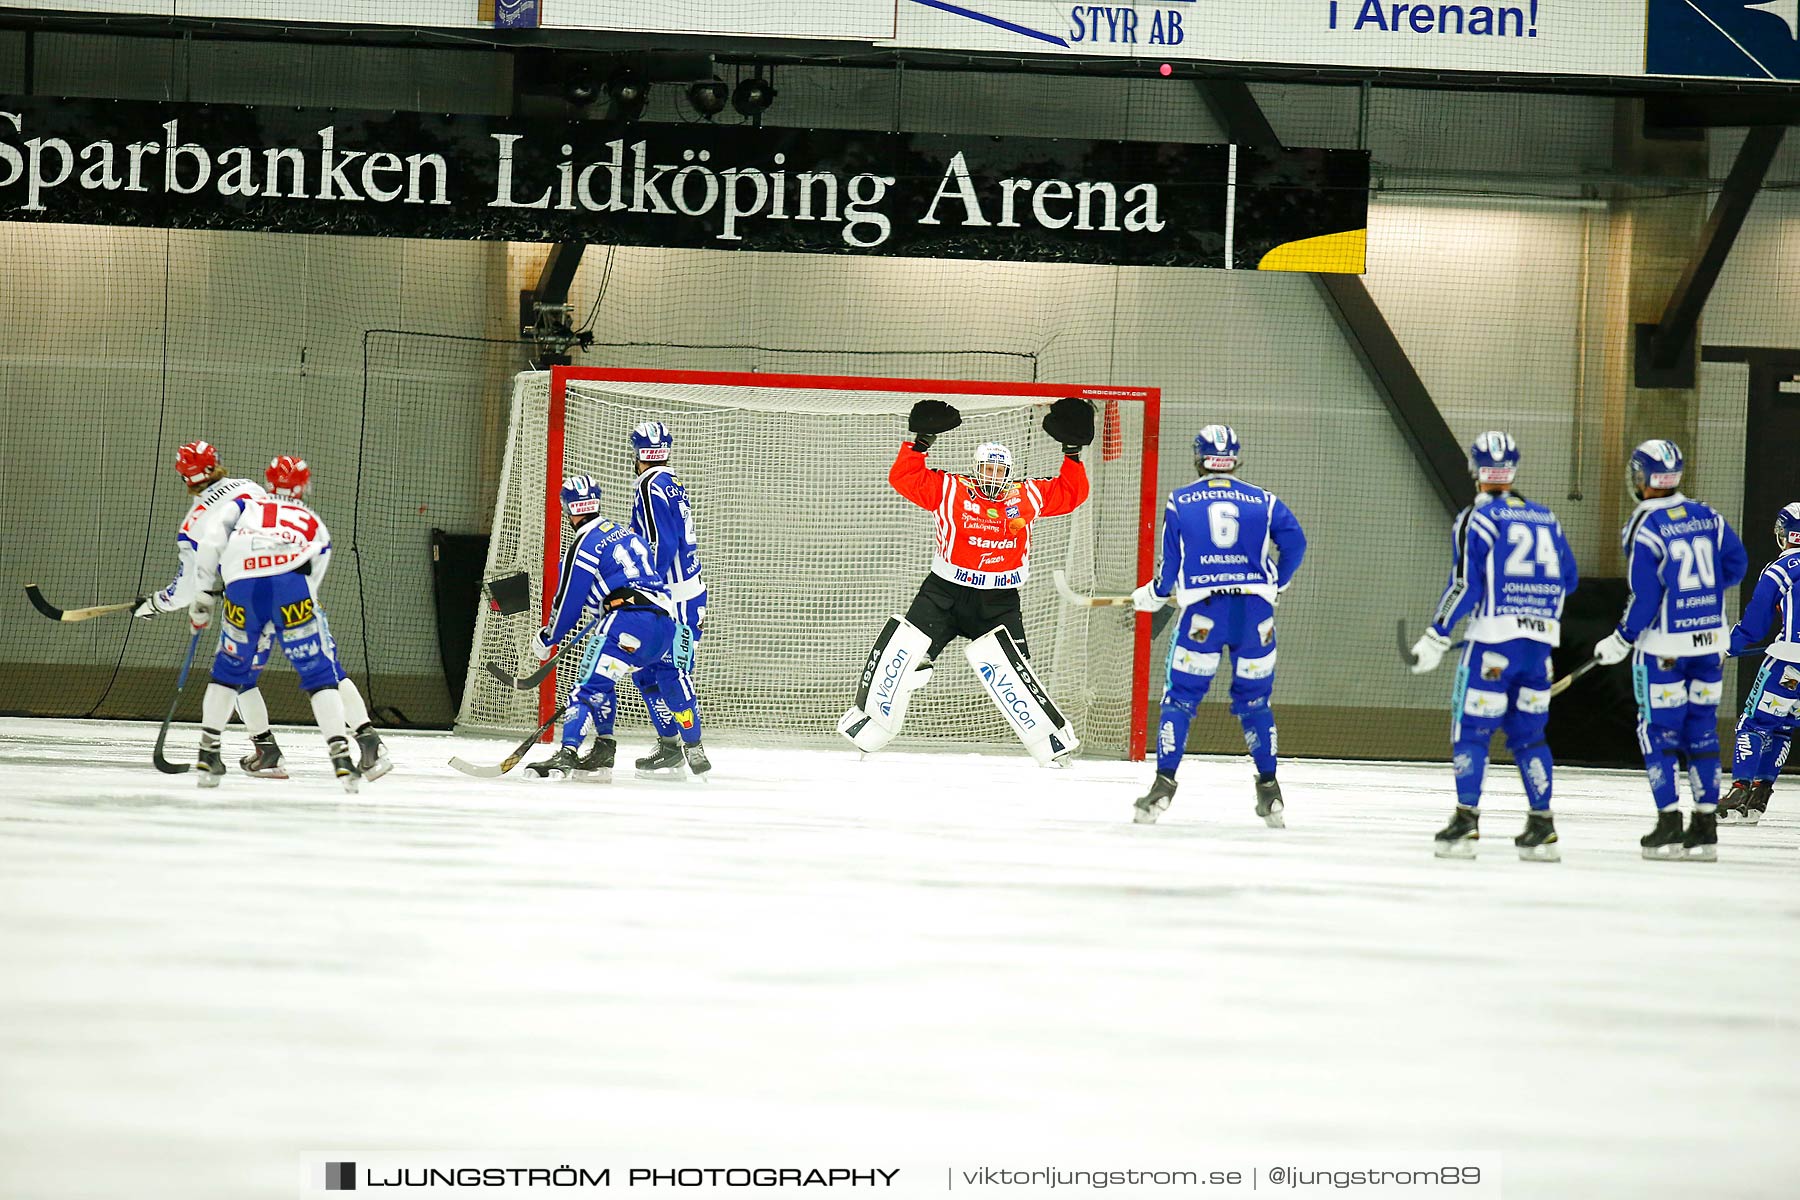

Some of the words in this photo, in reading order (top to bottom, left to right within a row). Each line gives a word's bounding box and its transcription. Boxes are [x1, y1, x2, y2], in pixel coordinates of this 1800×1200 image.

[1070, 5, 1137, 44] STYR
[1149, 8, 1184, 46] AB
[1354, 0, 1538, 38] Arenan!
[0, 111, 451, 211] Sparbanken
[488, 132, 896, 248] Lidköping
[917, 150, 1166, 233] Arena
[1178, 490, 1263, 505] Götenehus
[1207, 501, 1240, 549] 6
[612, 536, 654, 579] 11
[977, 552, 1005, 570] Fazer
[1200, 554, 1248, 565] KARLSSON
[1504, 521, 1561, 578] 24
[1668, 535, 1716, 592] 20
[280, 598, 313, 623] YVS
[862, 649, 880, 690] 1934
[876, 648, 909, 698] ViaCon
[1014, 661, 1047, 706] 1934
[998, 673, 1037, 730] ViaCon
